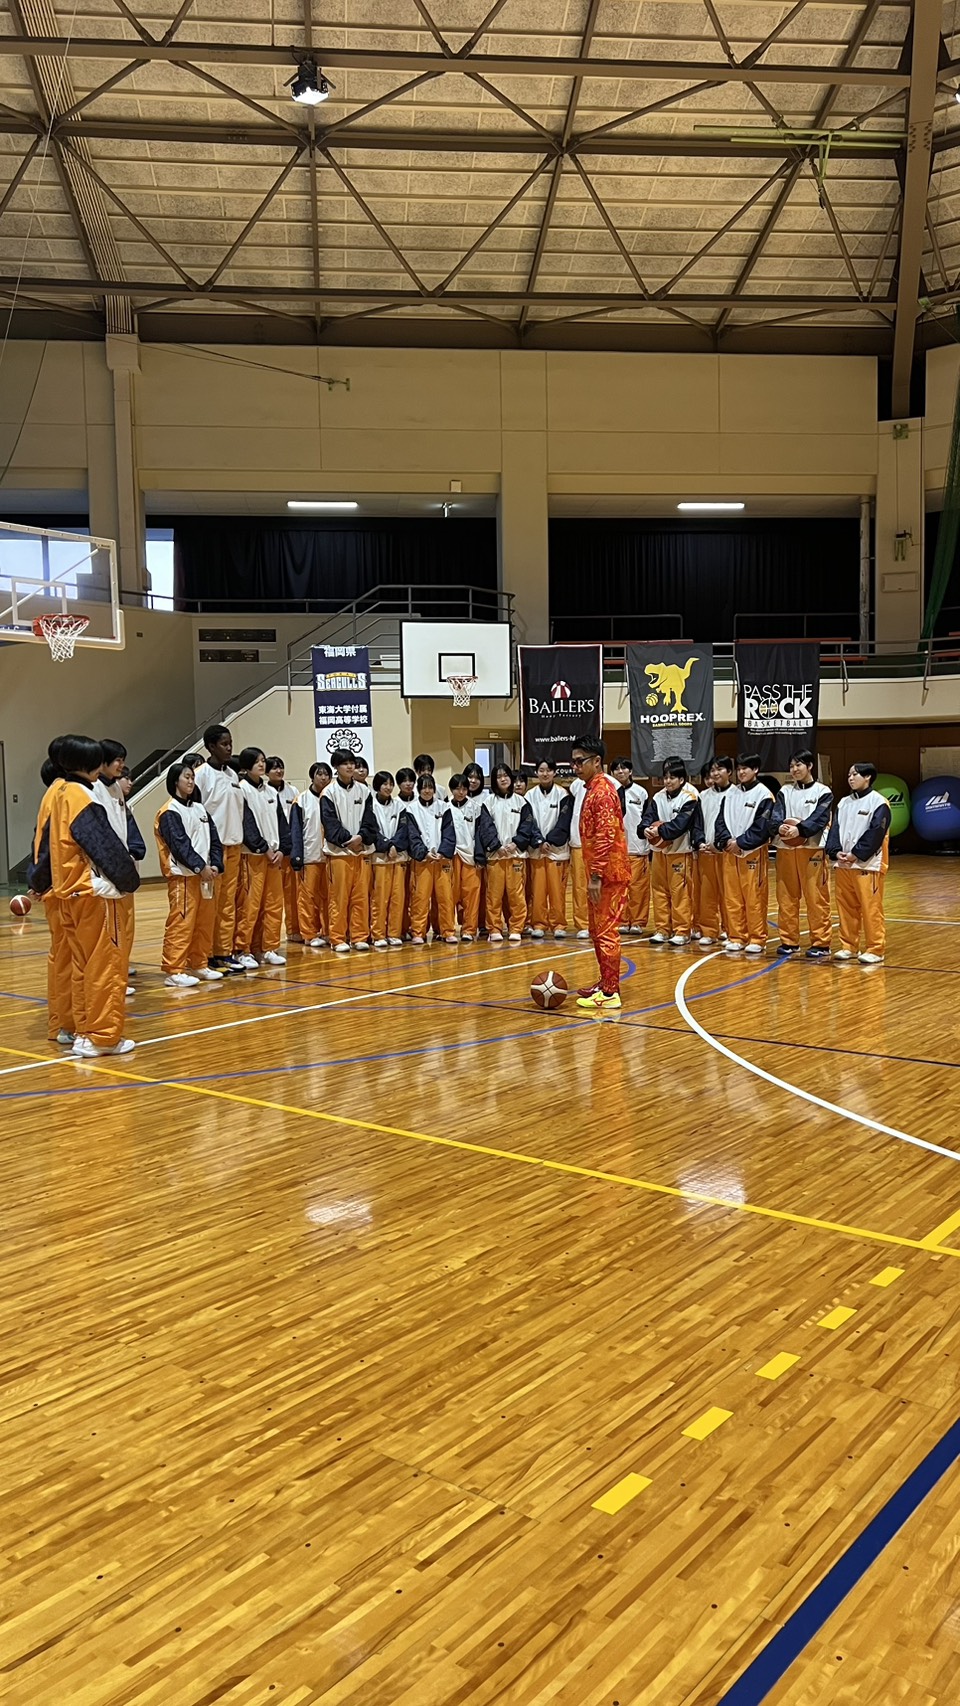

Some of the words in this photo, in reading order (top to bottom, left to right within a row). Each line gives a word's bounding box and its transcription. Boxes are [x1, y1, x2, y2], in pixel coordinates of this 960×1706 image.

[316, 673, 367, 691] SEAGULLS
[743, 684, 781, 700] PASS
[783, 684, 813, 700] THE
[318, 704, 368, 714] 東海大学付属
[529, 698, 595, 714] BALLER'S
[744, 697, 813, 719] ROCK
[319, 715, 368, 725] 福岡高等学校
[747, 719, 810, 727] BASKETBALL
